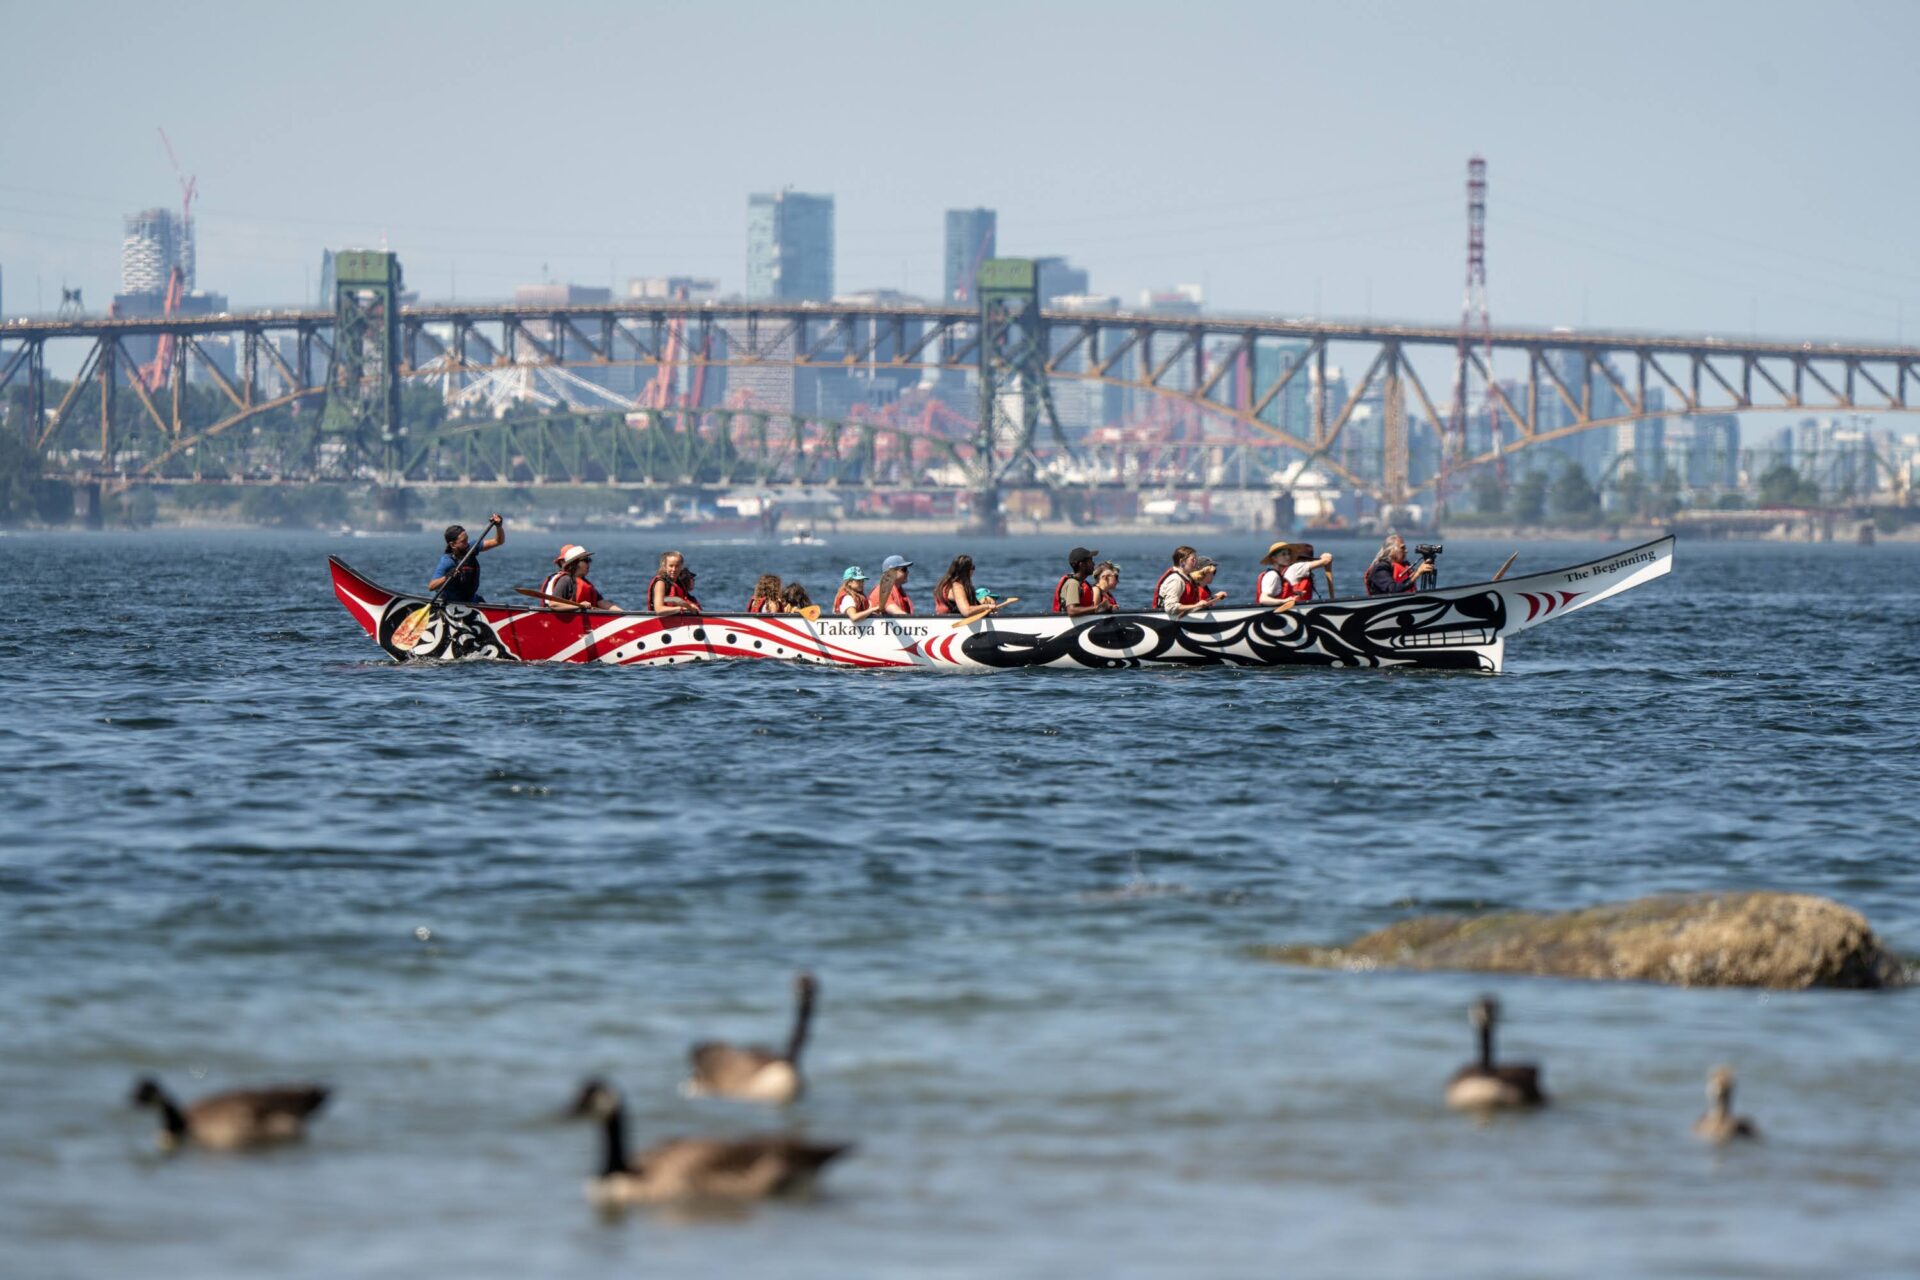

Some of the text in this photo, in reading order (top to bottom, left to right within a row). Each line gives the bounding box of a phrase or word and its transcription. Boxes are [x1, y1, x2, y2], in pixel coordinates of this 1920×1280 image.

[1565, 550, 1657, 582] The Beginning
[816, 621, 928, 639] Takaya Tours
